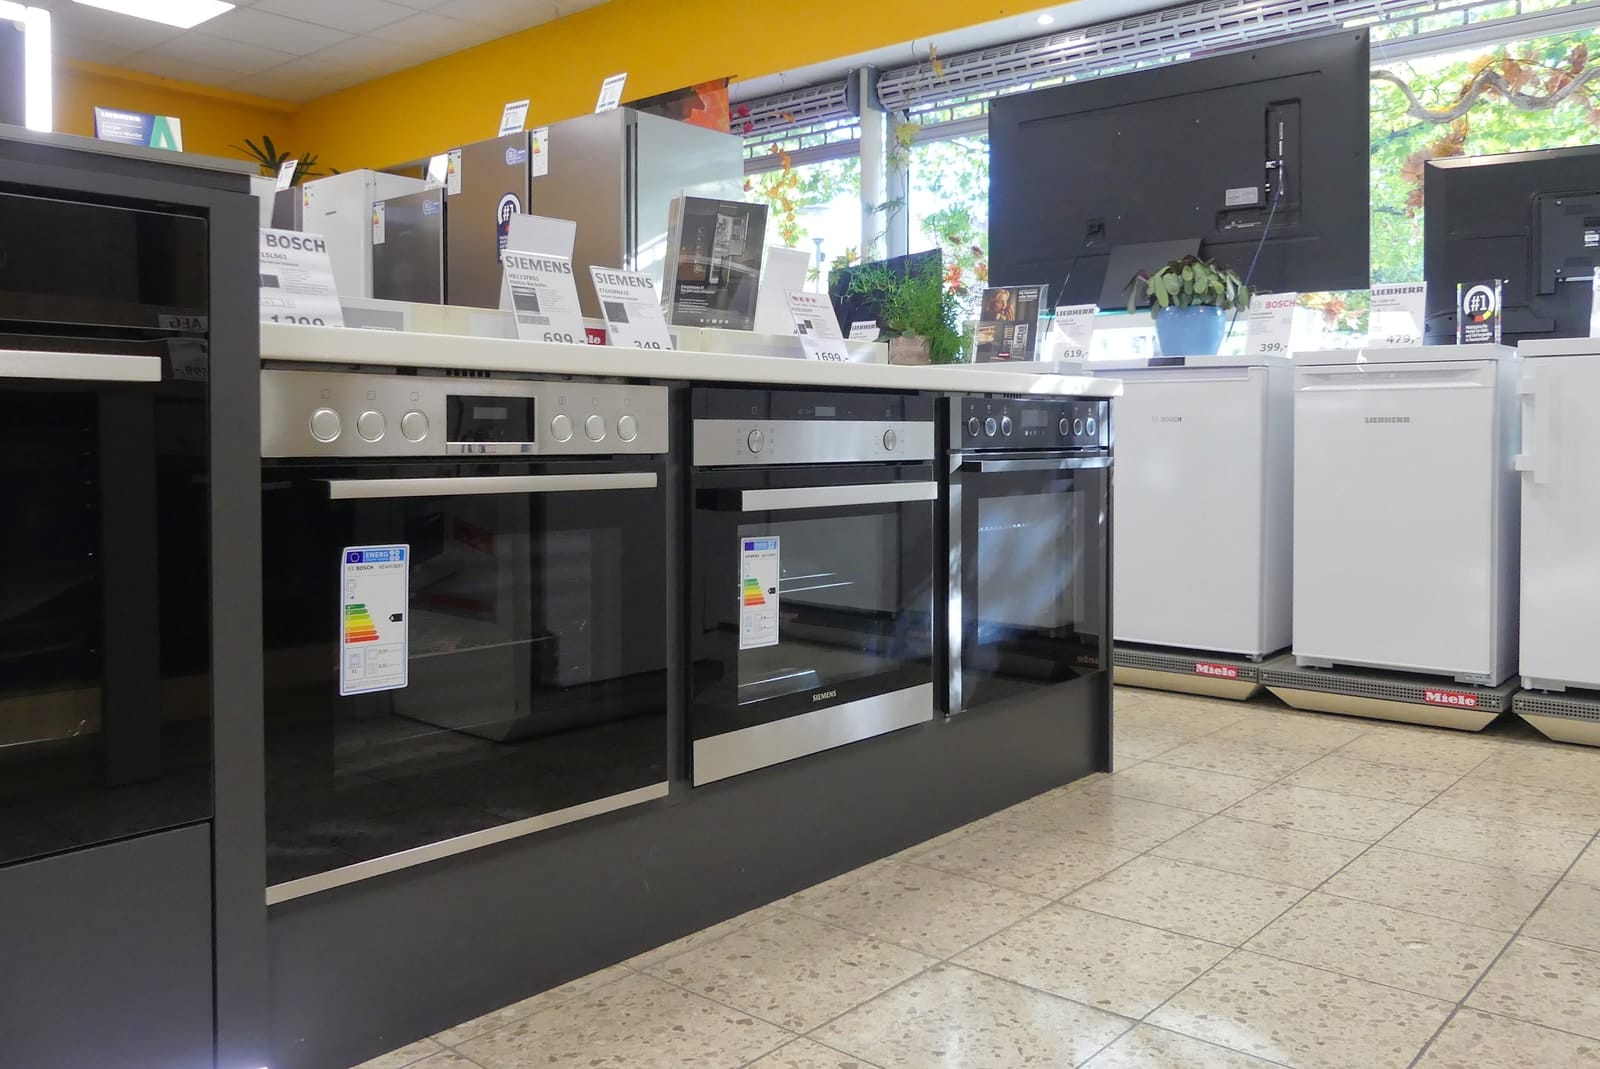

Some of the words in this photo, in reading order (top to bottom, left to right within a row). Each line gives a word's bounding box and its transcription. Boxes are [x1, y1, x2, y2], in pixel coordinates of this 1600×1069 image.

[265, 233, 327, 254] BOSCH
[504, 255, 572, 274] SIEMENS
[594, 272, 654, 289] SIEMENS
[1371, 286, 1425, 297] LIEBHERR
[1264, 300, 1297, 309] BOSCH
[1470, 294, 1488, 312] #1
[1056, 308, 1095, 317] LIEBHERR
[1195, 662, 1237, 678] Miele
[812, 689, 837, 702] SIEMENS
[1425, 690, 1477, 707] Miele
